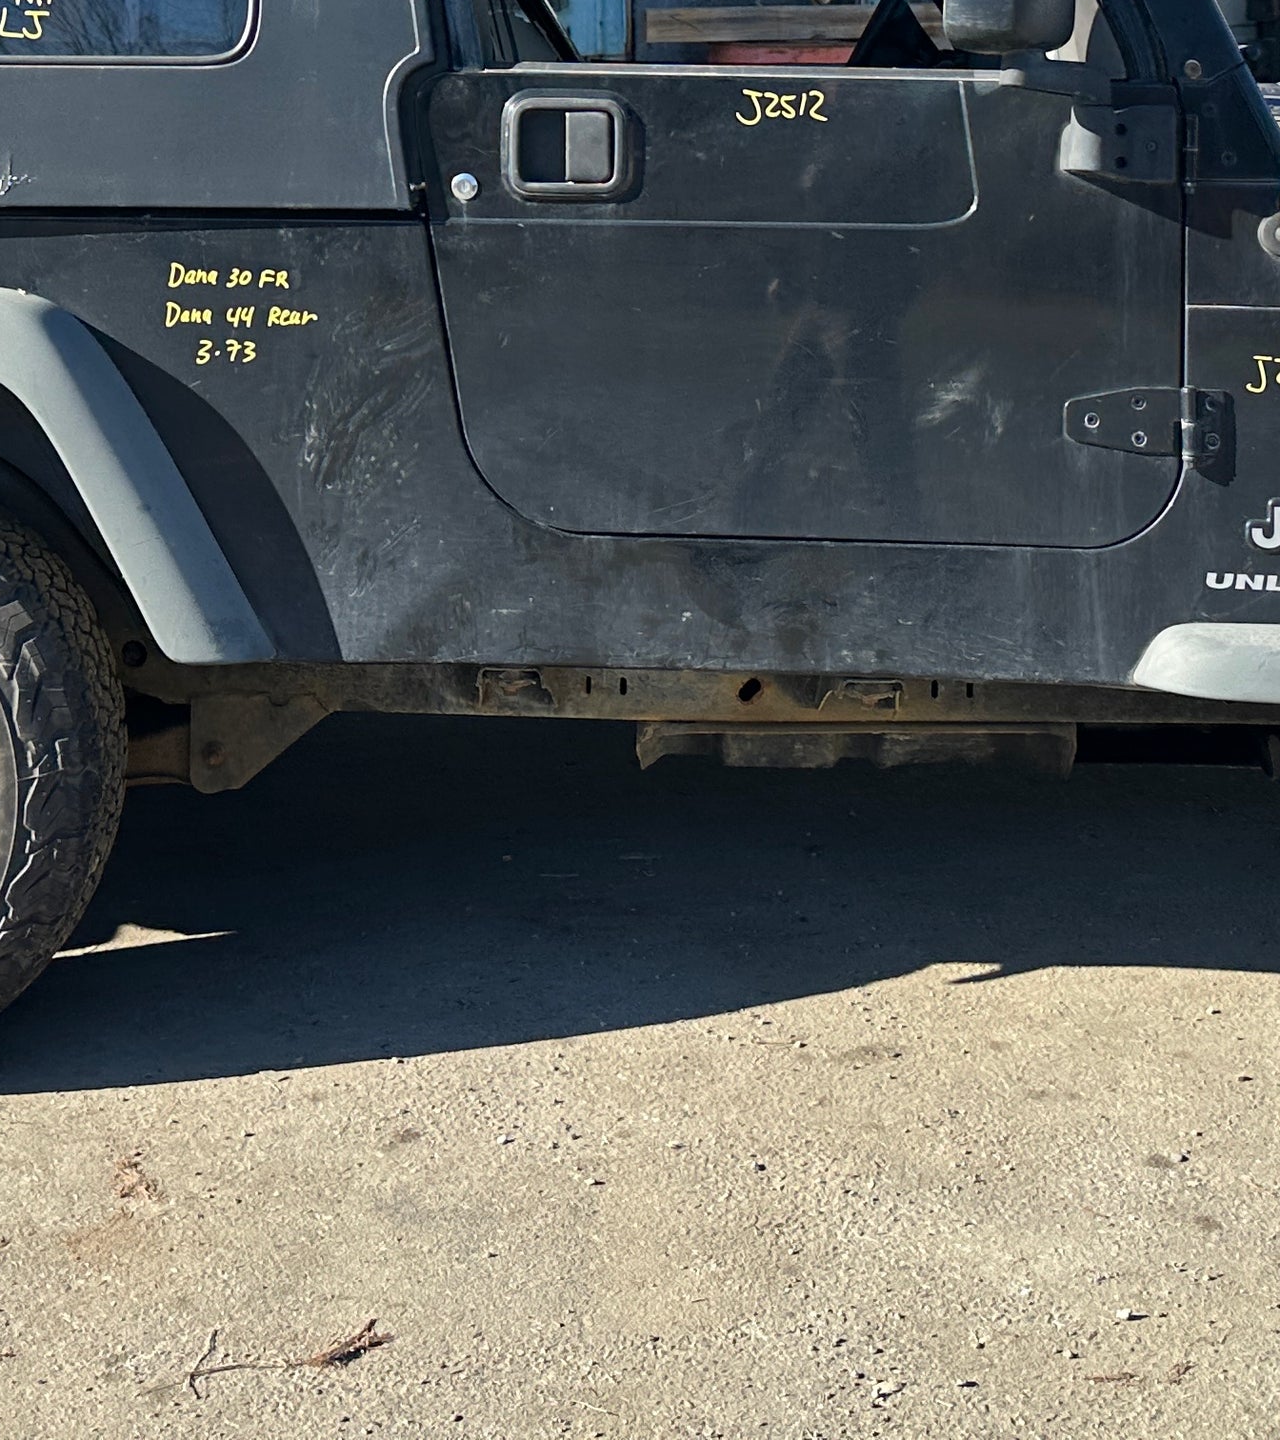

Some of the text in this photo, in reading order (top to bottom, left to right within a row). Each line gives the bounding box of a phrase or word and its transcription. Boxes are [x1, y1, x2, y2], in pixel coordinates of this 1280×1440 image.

[735, 89, 829, 126] J2512
[168, 262, 290, 289] Dana 30 FR
[165, 301, 318, 328] Dana 44 Rear
[195, 339, 257, 365] 3.73
